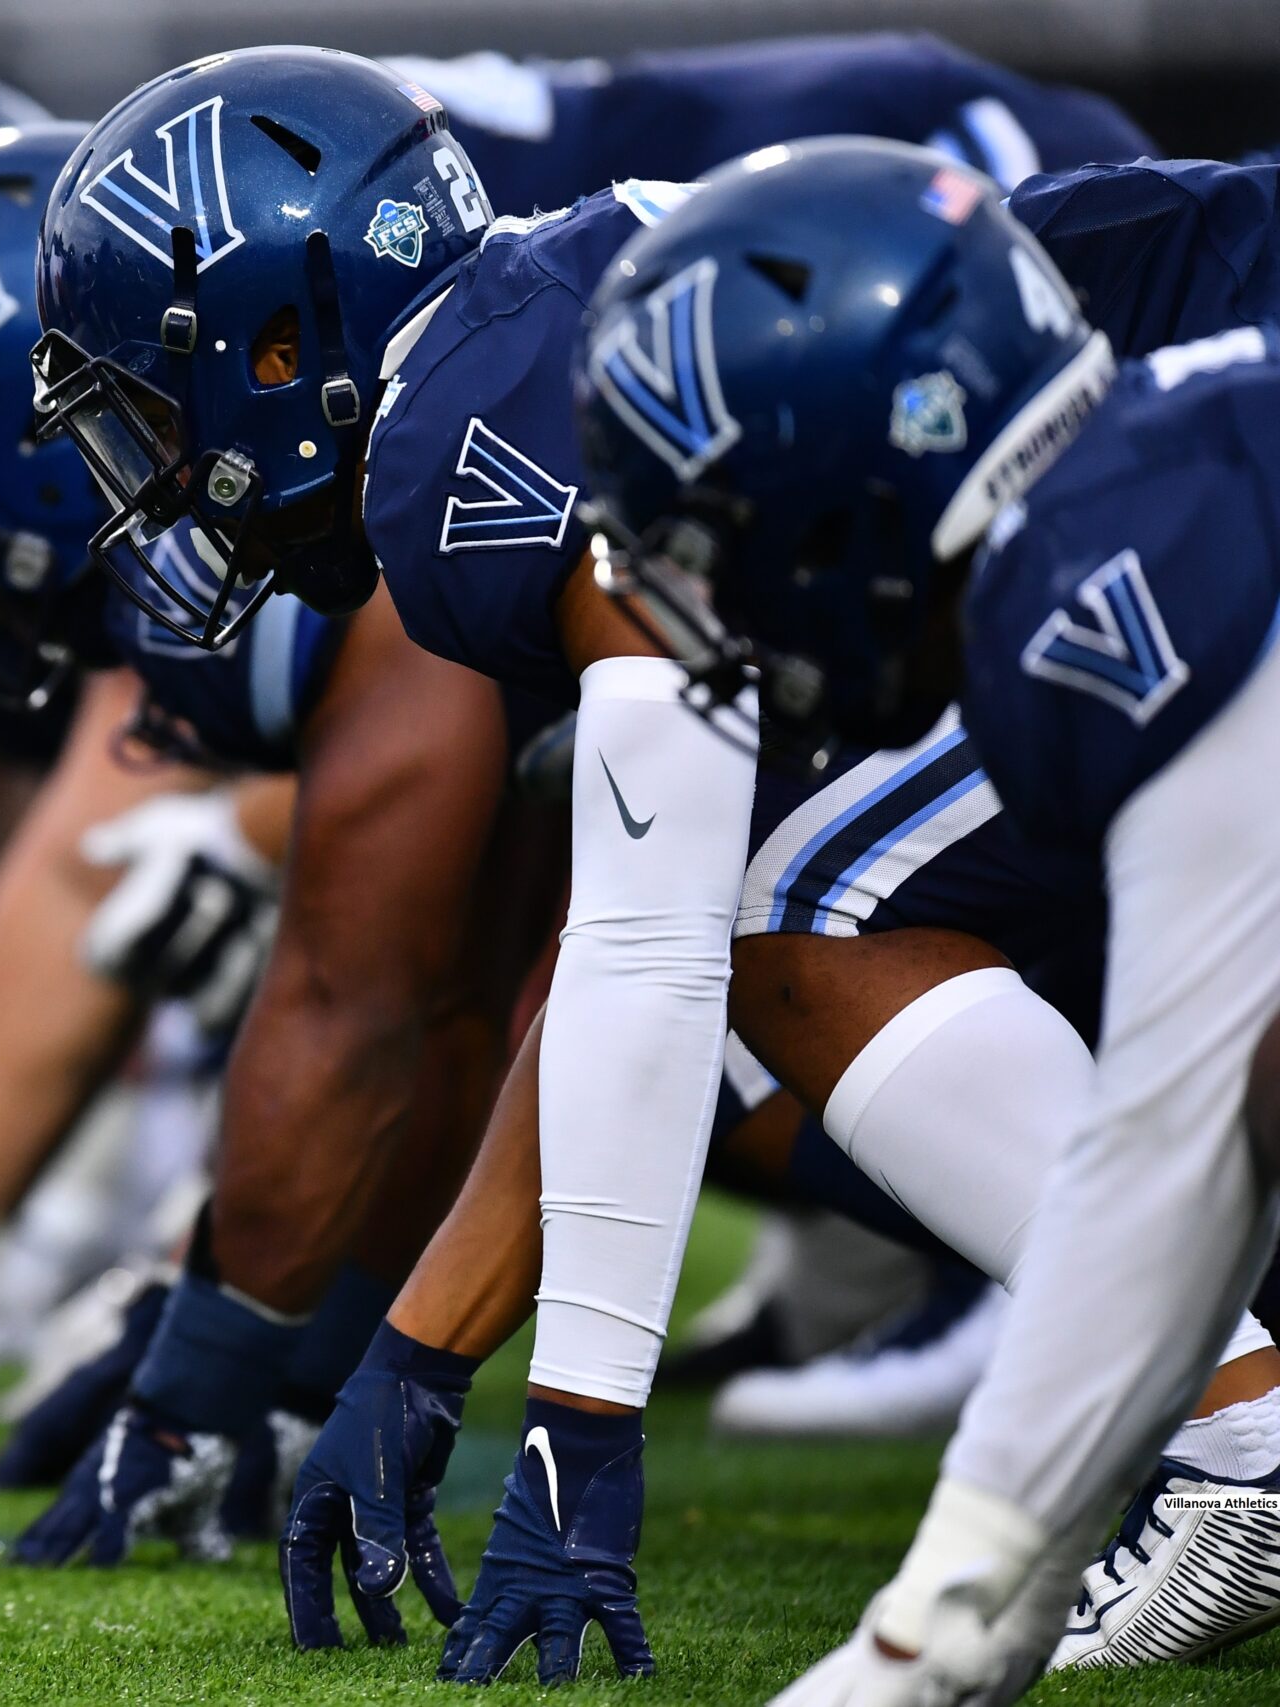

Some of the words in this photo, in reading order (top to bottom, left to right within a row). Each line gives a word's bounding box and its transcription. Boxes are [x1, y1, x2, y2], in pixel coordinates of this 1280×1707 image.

[81, 95, 246, 275] V
[377, 215, 418, 245] FCS
[589, 256, 743, 481] V
[439, 417, 578, 552] V
[1022, 548, 1191, 727] V
